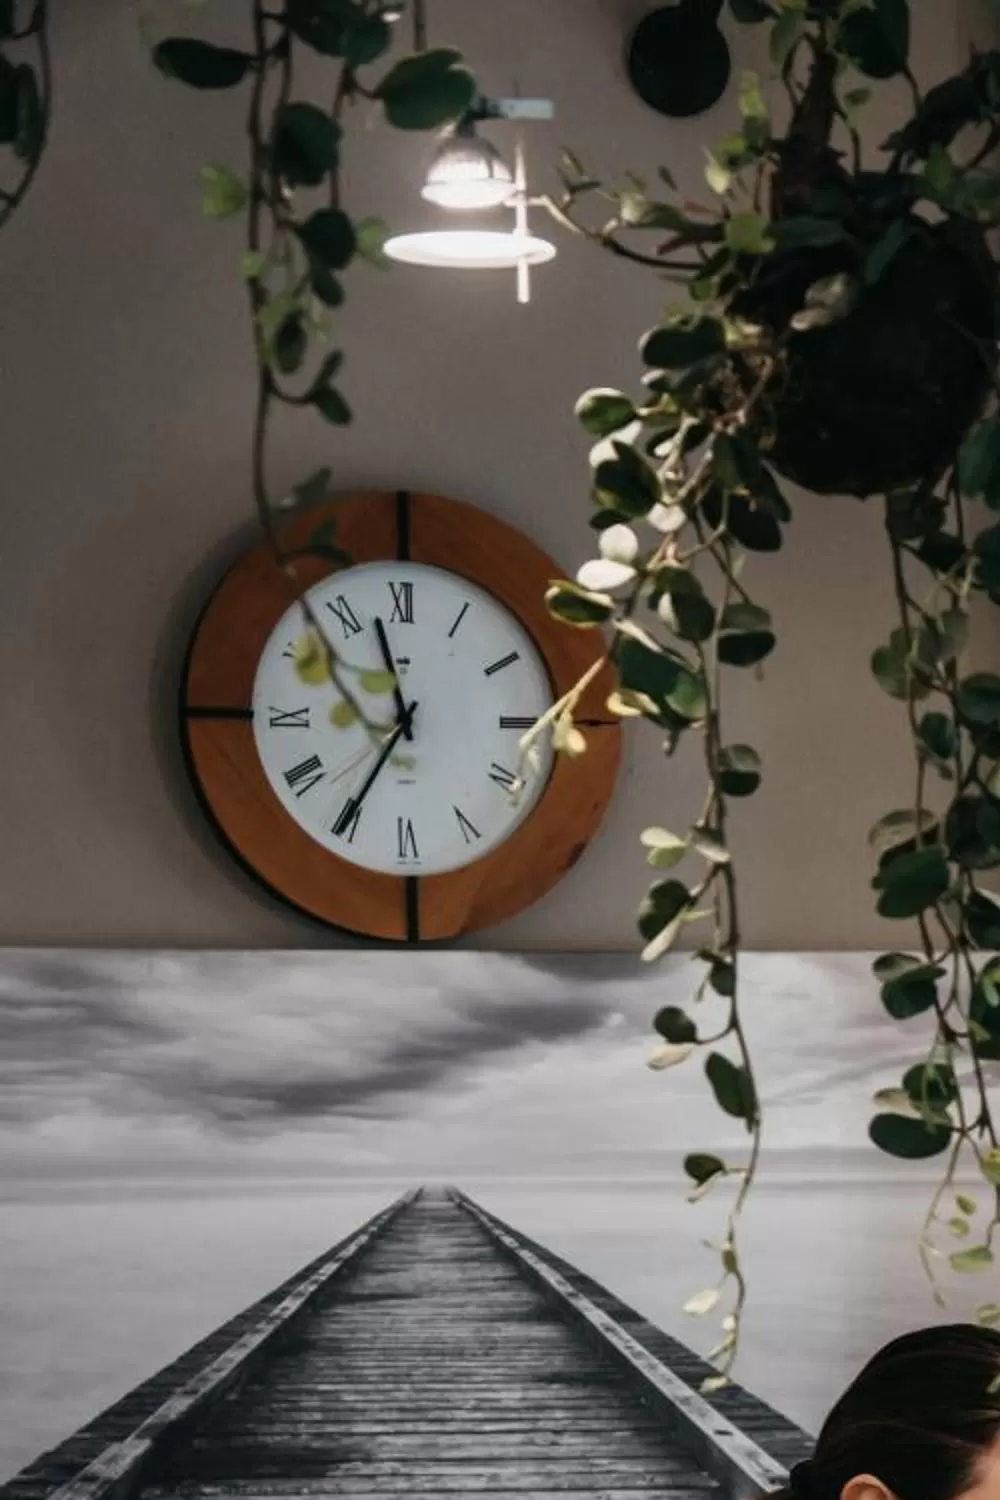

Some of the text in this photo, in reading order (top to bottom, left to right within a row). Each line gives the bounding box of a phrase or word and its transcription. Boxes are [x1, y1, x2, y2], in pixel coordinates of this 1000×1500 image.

[325, 594, 364, 639] XI
[388, 581, 415, 624] XII
[483, 650, 520, 676] II
[269, 705, 310, 729] IX
[499, 715, 541, 729] III
[283, 753, 328, 798] VIII
[397, 815, 419, 859] VI
[453, 804, 483, 844] V
